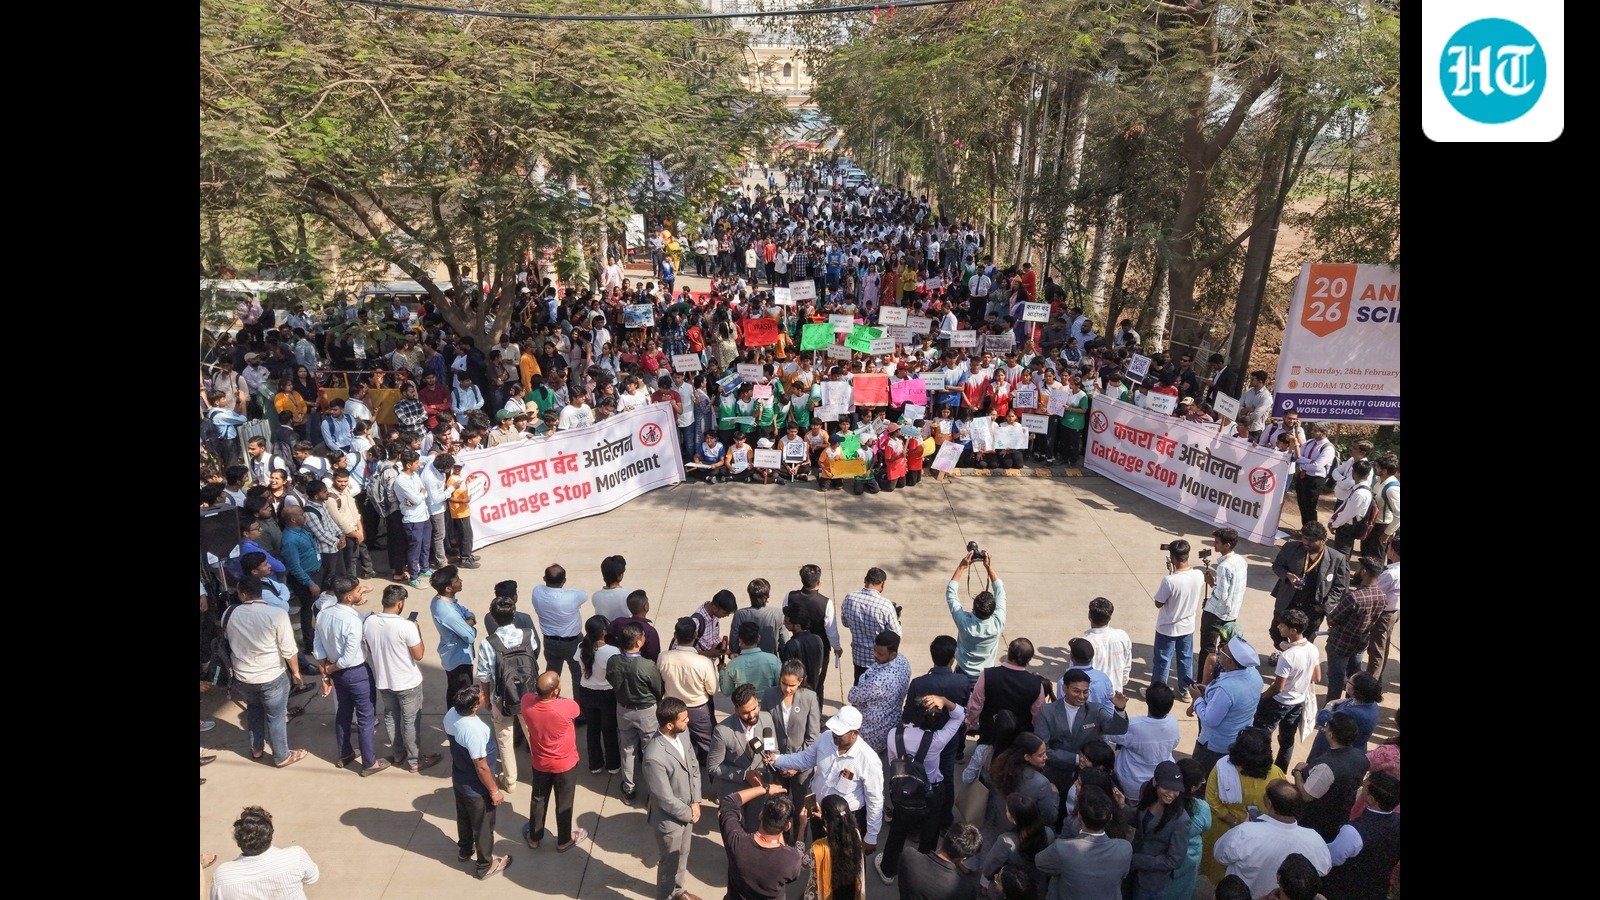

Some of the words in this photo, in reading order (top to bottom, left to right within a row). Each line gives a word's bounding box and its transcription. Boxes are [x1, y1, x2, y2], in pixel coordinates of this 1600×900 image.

[1311, 277, 1348, 299] 20
[1307, 301, 1342, 322] 26
[1304, 366, 1342, 376] Saturday,
[1344, 368, 1362, 376] 28th
[1364, 369, 1399, 378] February
[1302, 381, 1337, 389] 10:00AM
[1353, 383, 1384, 391] 2:00PM
[1296, 406, 1327, 414] WORLD
[1329, 407, 1365, 416] SCHOOL
[1297, 398, 1366, 408] VISHWASHANTI
[497, 459, 548, 488] कचरा
[549, 450, 579, 476] बंद
[582, 433, 633, 469] आंदोलन
[1113, 421, 1153, 450] कचरा
[1154, 433, 1179, 459] बंद
[1178, 443, 1242, 484] आंदोलन
[480, 491, 550, 524] Garbage
[552, 480, 592, 504] Stop
[595, 453, 661, 493] Movement
[1090, 440, 1144, 473] Garbage
[1146, 459, 1178, 488] Stop
[1179, 473, 1262, 519] Movement
